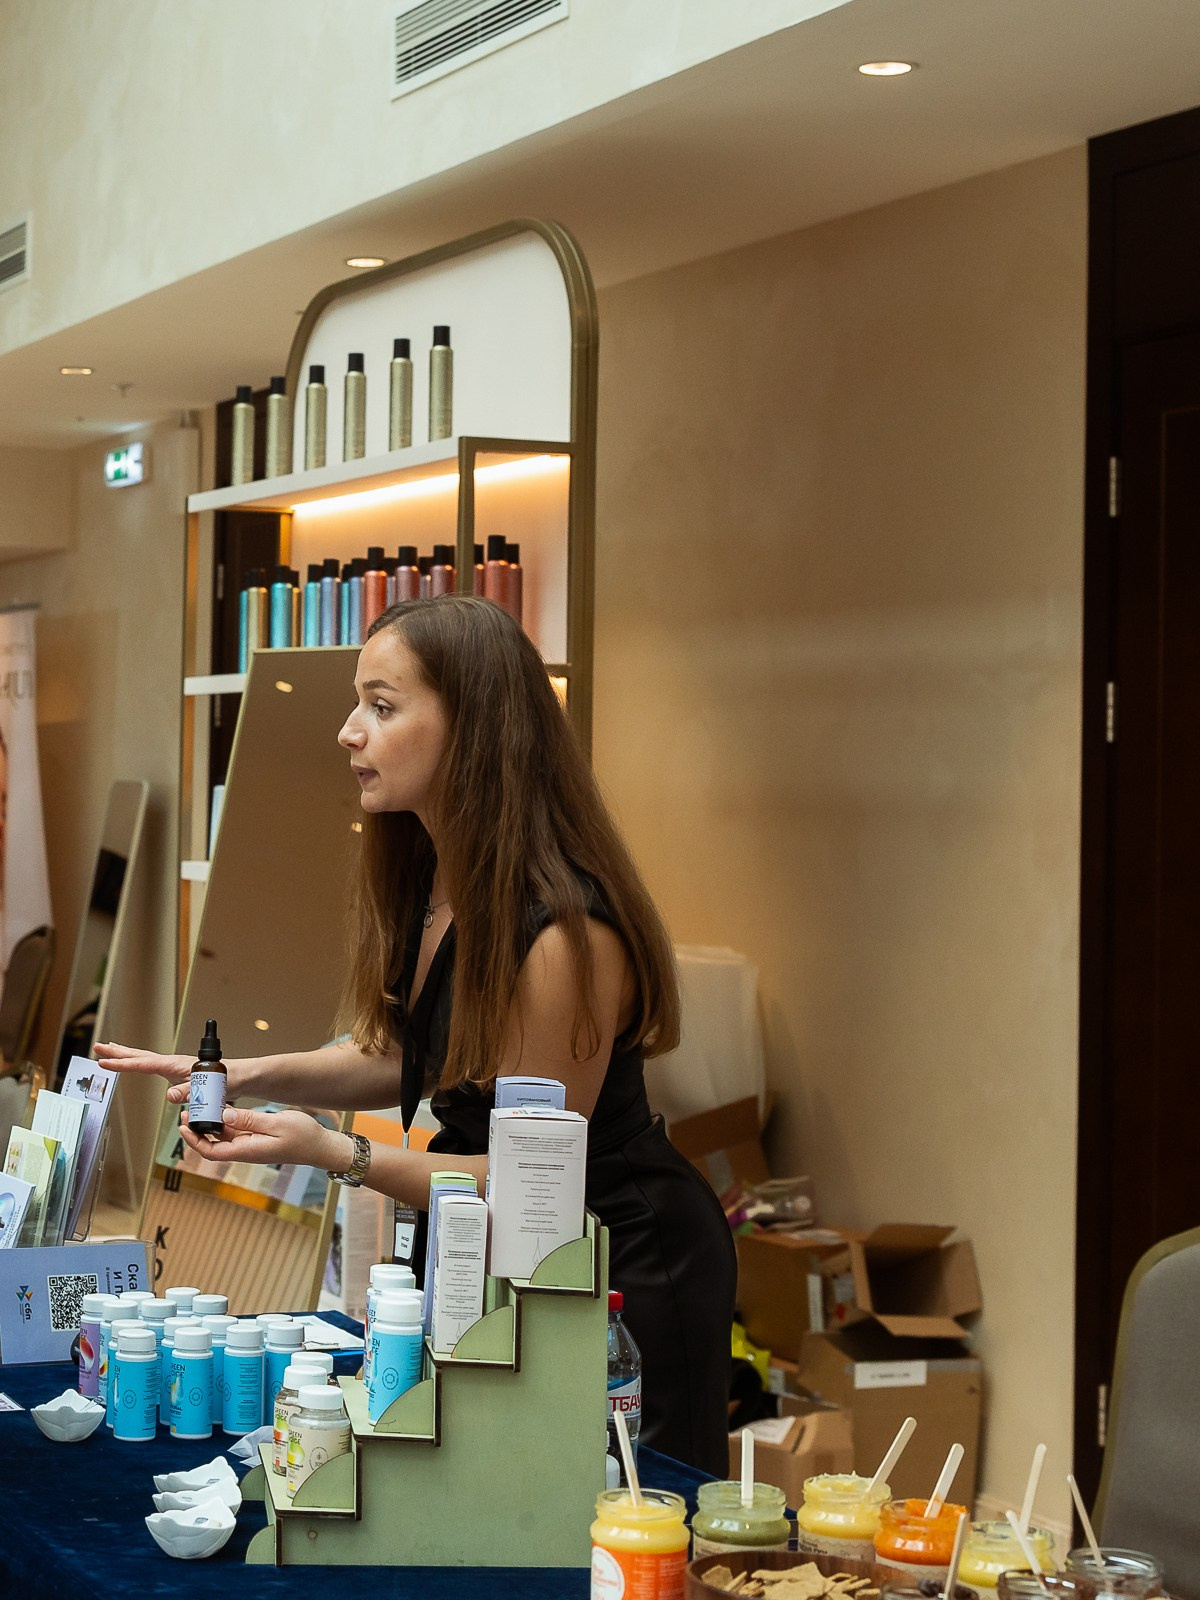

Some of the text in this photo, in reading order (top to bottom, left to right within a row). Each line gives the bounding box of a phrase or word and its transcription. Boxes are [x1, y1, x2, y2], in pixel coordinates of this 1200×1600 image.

[113, 1271, 122, 1280] и
[127, 1263, 140, 1291] Ска
[24, 1302, 33, 1320] сбп
